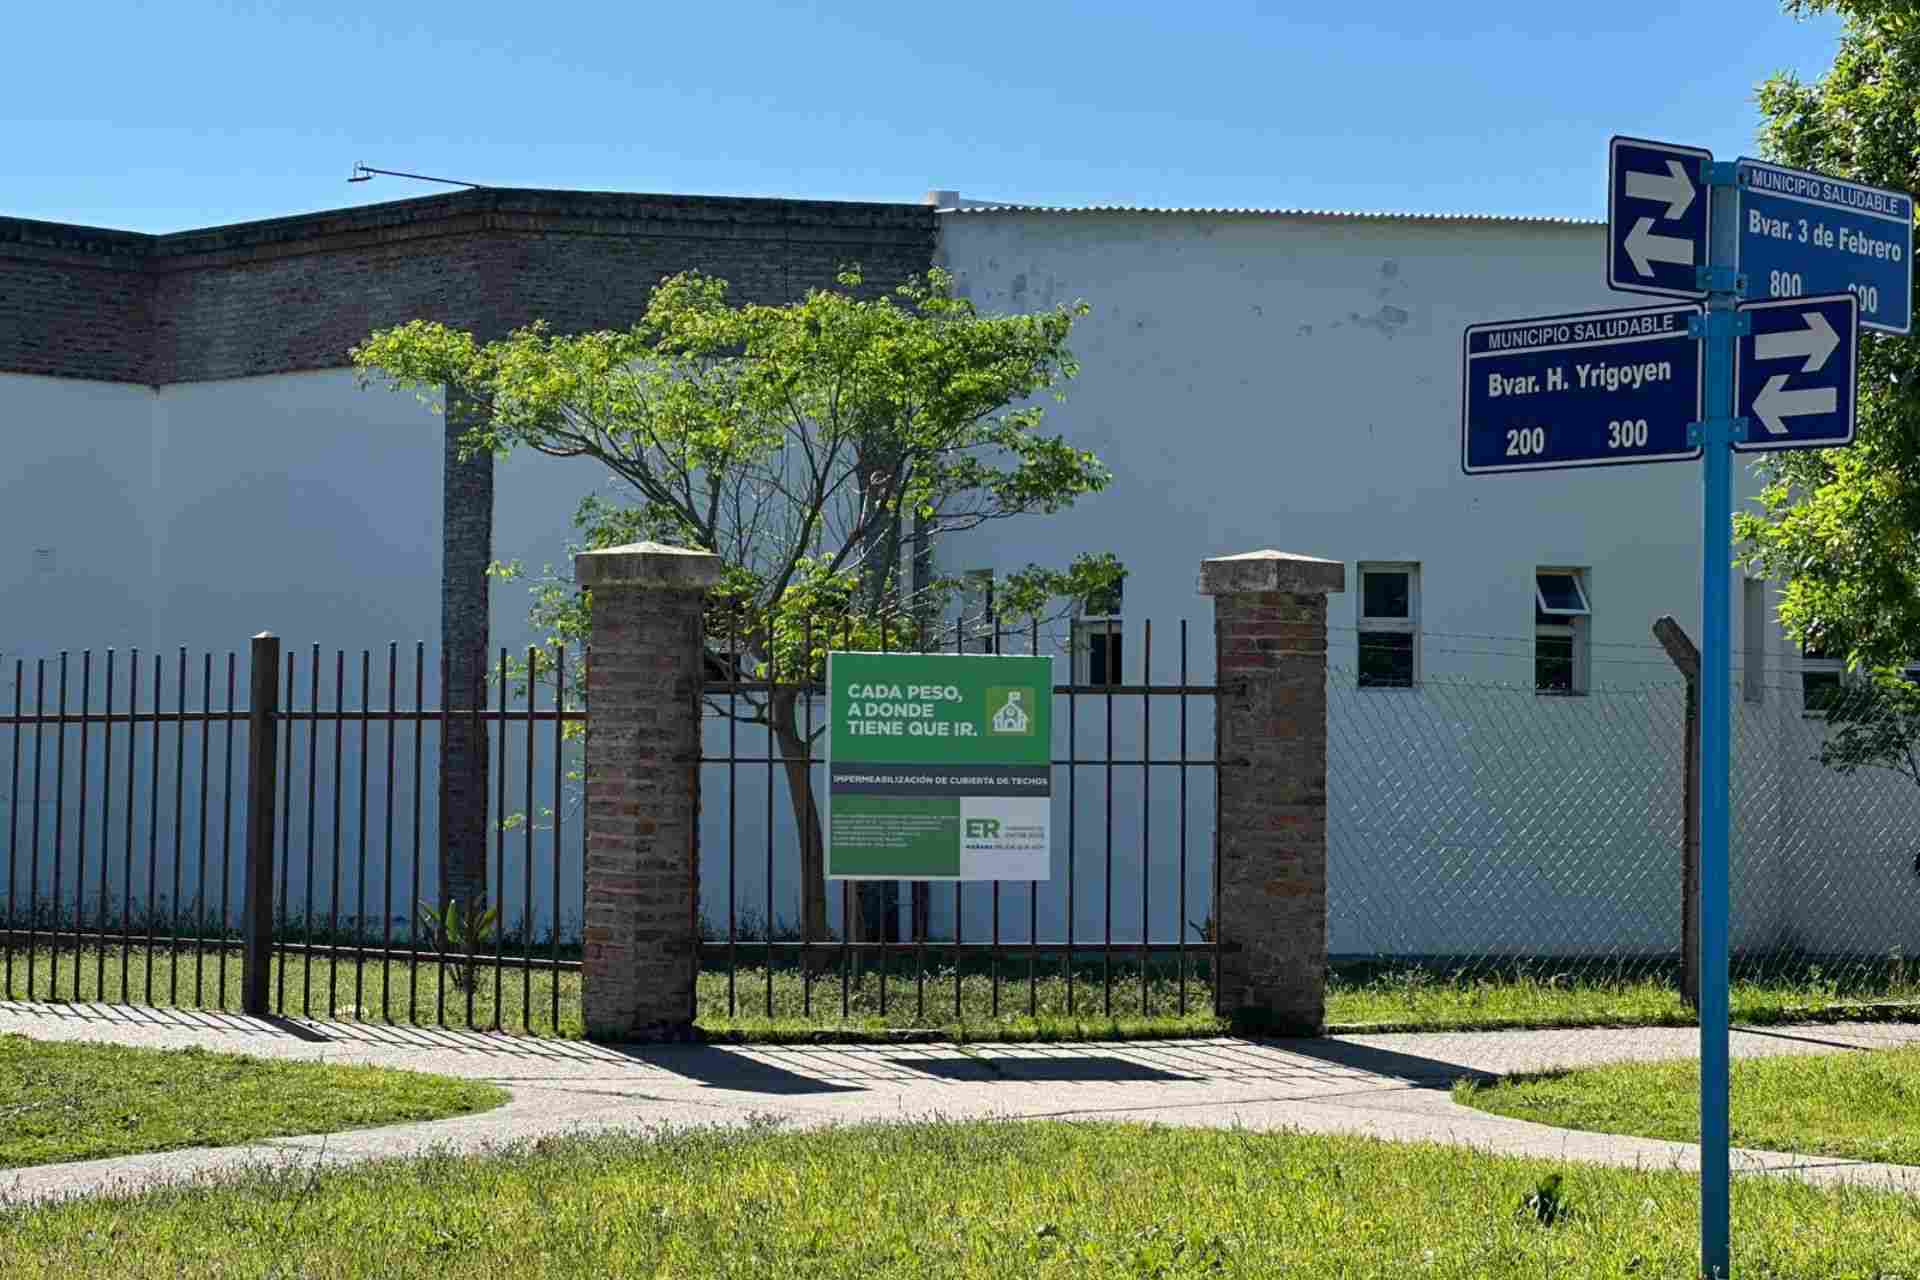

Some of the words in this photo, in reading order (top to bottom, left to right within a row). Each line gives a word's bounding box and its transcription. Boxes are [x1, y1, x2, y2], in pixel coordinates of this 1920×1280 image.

[1751, 169, 1820, 198] MUNICIPIO
[1823, 185, 1898, 214] SALUDABLE
[1749, 208, 1793, 241] Bvar.
[1798, 219, 1808, 243] 3
[1813, 223, 1833, 248] de
[1839, 227, 1901, 262] Febrero
[1770, 269, 1802, 297] 800
[1488, 326, 1570, 349] MUNICIPIO
[1574, 314, 1674, 341] SALUDABLE
[1488, 373, 1540, 397] Bvar.
[1547, 367, 1569, 391] H.
[1576, 360, 1672, 391] Yrigoyen
[1506, 427, 1545, 456] 200
[1608, 419, 1649, 448] 300
[847, 683, 903, 699] CADA
[907, 685, 964, 703] PESO,
[847, 703, 861, 717] A
[865, 703, 934, 718] DONDE
[847, 720, 903, 736] TIENE
[908, 721, 949, 737] QUE
[954, 722, 978, 737] IR.
[935, 776, 947, 785] DE
[966, 819, 1000, 838] ER
